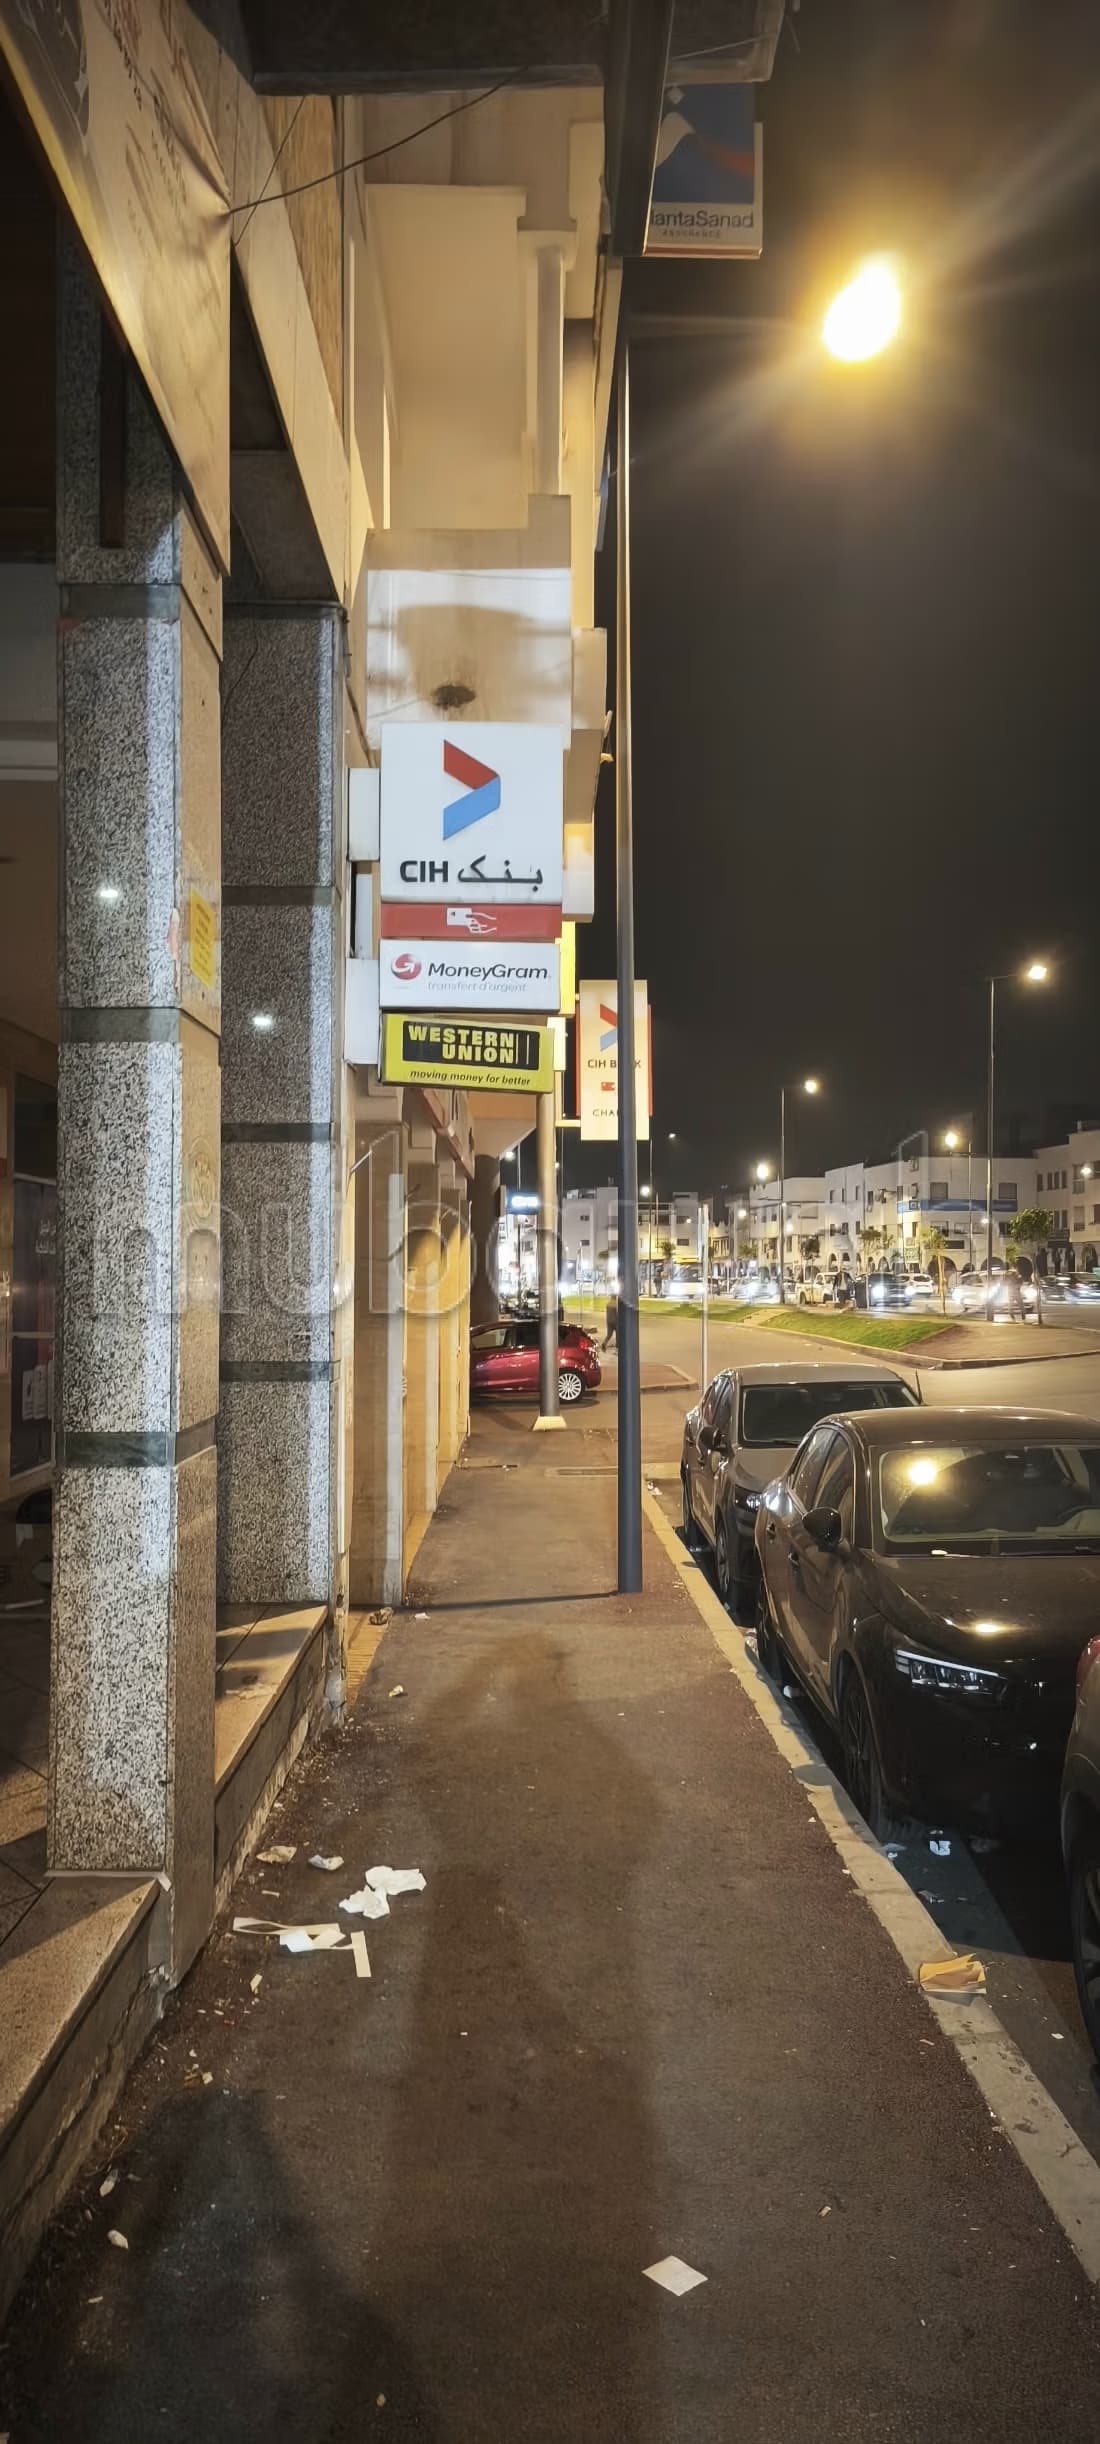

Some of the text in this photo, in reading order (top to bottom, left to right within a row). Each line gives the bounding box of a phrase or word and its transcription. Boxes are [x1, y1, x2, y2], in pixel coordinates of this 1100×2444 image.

[399, 860, 449, 883] CIH
[428, 962, 548, 981] MoneyGram
[427, 981, 527, 993] transfert d'argent
[408, 1024, 514, 1048] WESTERN
[441, 1043, 514, 1064] UNION
[587, 1059, 642, 1069] CIH BK
[410, 1070, 531, 1086] moving money for better
[592, 1108, 618, 1117] CHA
